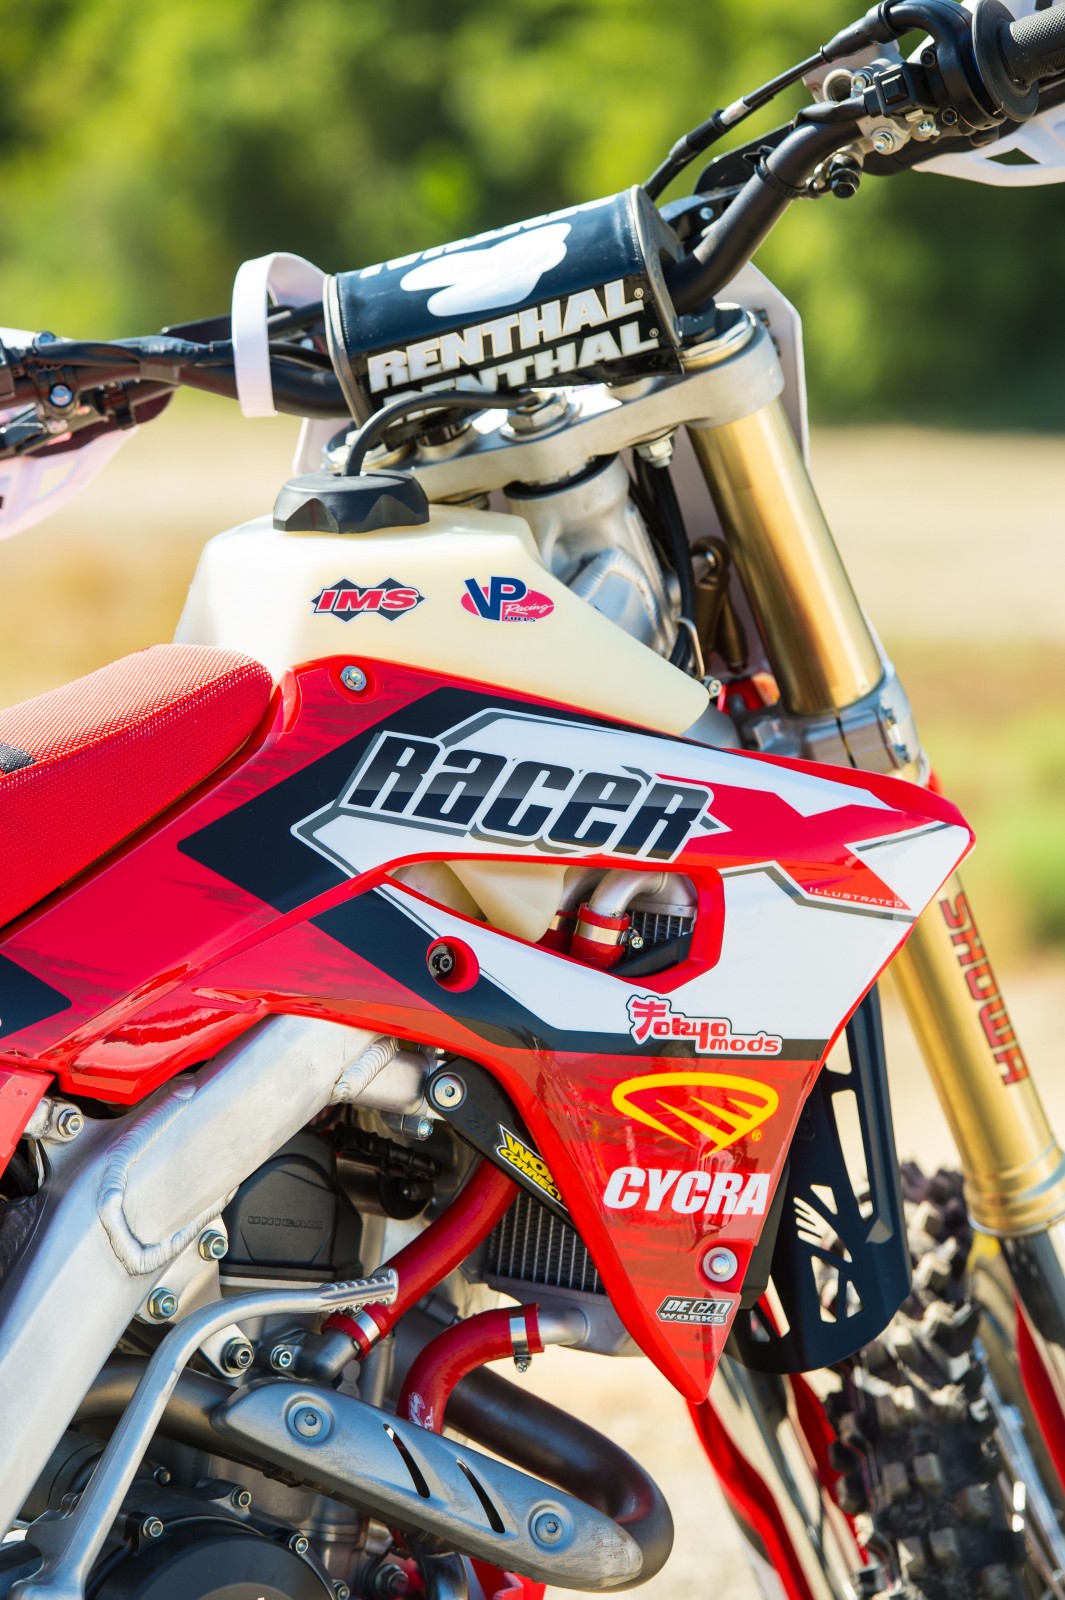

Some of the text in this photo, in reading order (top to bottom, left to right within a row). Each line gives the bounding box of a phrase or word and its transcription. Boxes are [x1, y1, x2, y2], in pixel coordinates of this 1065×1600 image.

[367, 279, 644, 393] RENTHAL
[317, 588, 420, 611] IMS
[464, 576, 527, 621] VP
[505, 603, 554, 615] Racing
[809, 886, 904, 908] ILLUSTRATED
[939, 891, 1029, 1086] SHOWA
[710, 1036, 779, 1053] mods
[603, 1166, 771, 1216] CYCRA
[247, 1216, 323, 1230] UNICAM
[659, 1312, 725, 1323] WORKS
